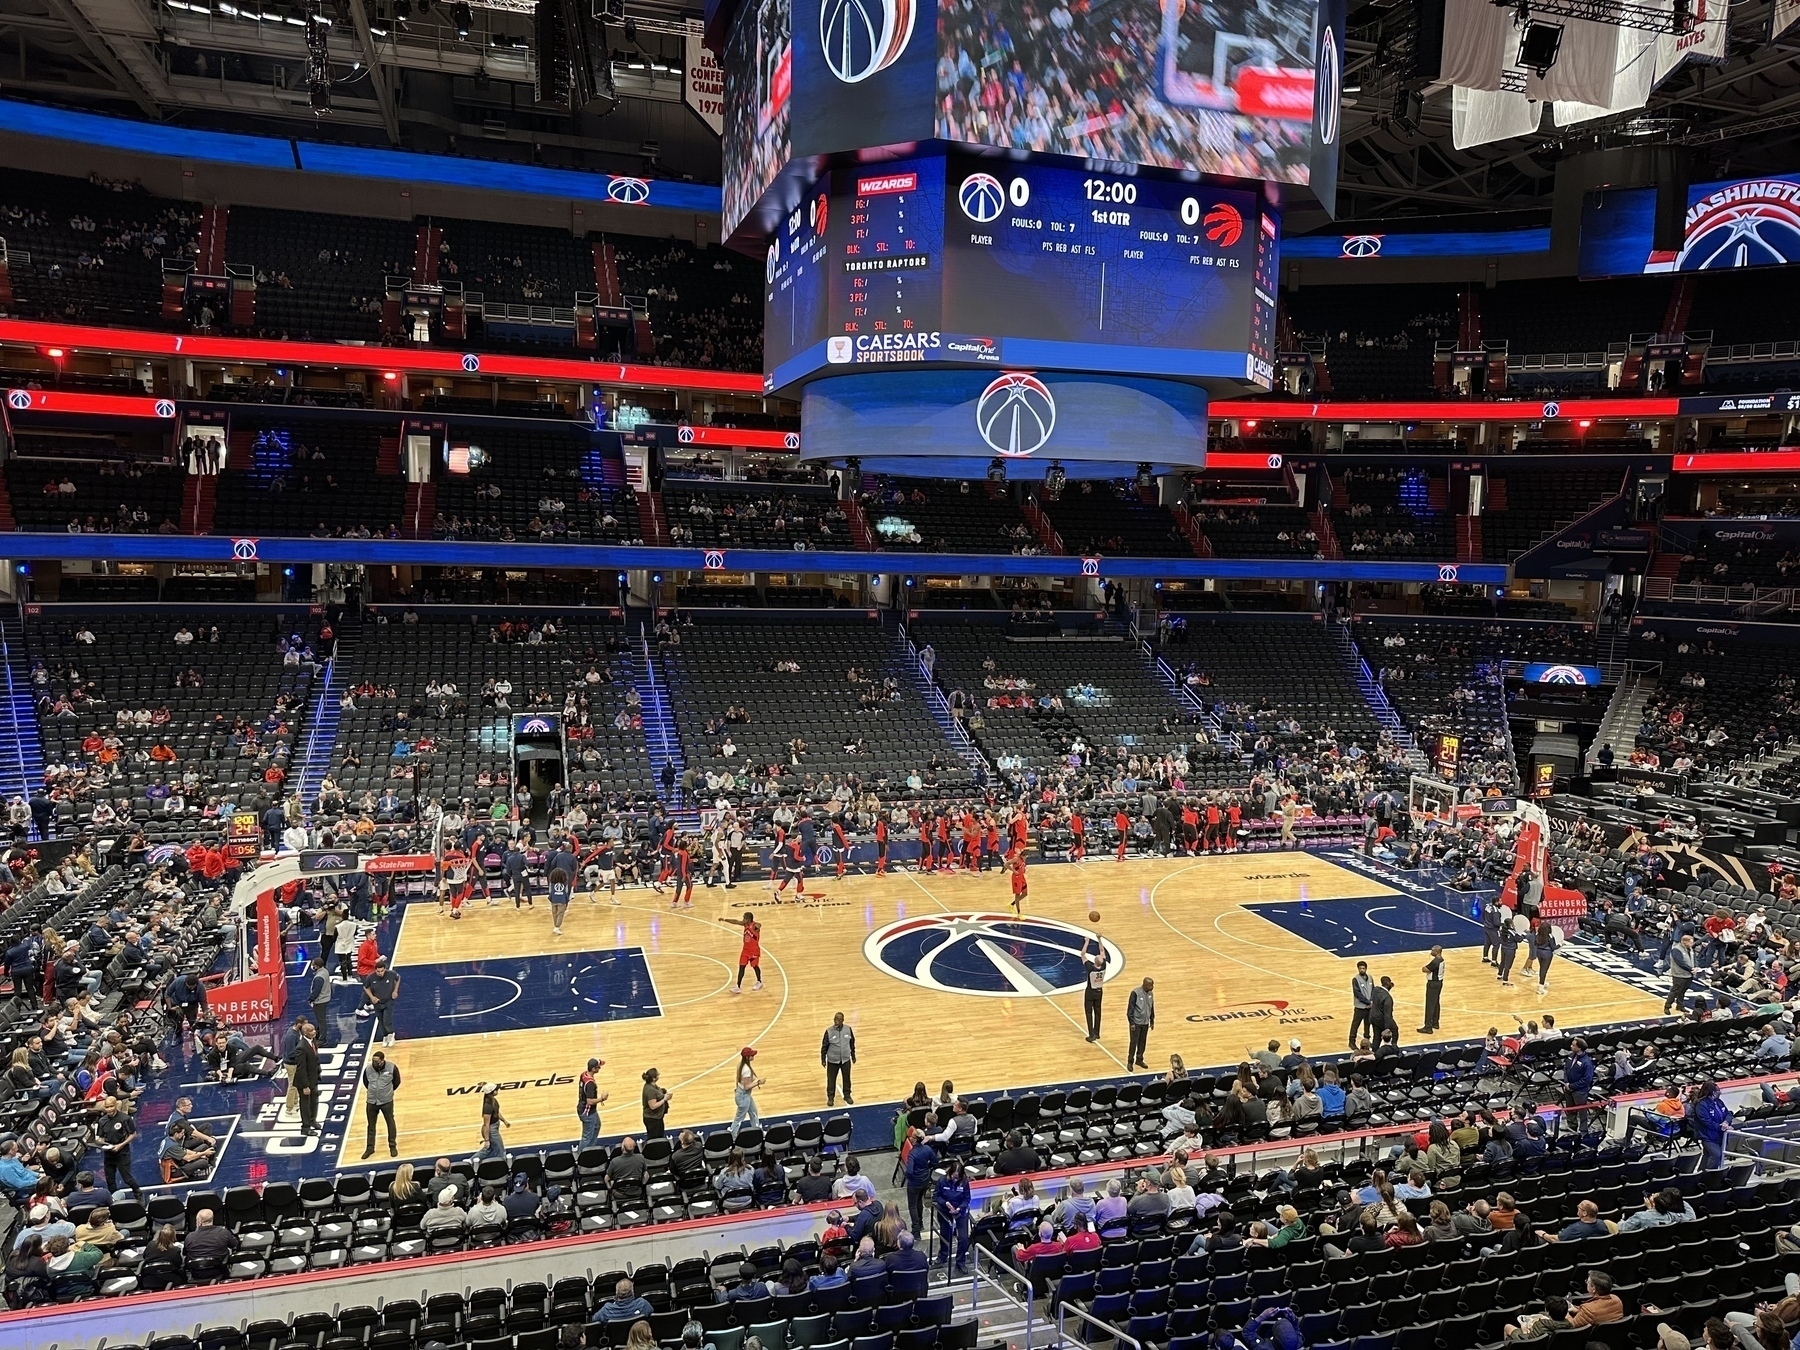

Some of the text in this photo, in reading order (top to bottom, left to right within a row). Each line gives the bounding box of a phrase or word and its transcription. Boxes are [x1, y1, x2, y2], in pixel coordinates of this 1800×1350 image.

[1676, 29, 1706, 52] HAYES
[699, 99, 724, 115] 1970
[860, 177, 914, 192] WIZARDS
[1083, 178, 1137, 204] 12:00
[1009, 177, 1030, 207] 0
[856, 200, 866, 210] FG:
[1181, 197, 1200, 226] 0
[810, 200, 816, 228] 0
[856, 214, 866, 224] PT:
[1091, 209, 1130, 226] 1st QTR
[1050, 222, 1066, 232] TOL:
[1070, 223, 1076, 232] 7
[856, 230, 865, 238] FT:
[970, 234, 992, 246] PLAYER
[1176, 234, 1190, 244] TOL:
[1194, 235, 1199, 244] 7
[774, 238, 780, 262] 0
[846, 240, 916, 254] BLK: STL: TO:
[1042, 242, 1096, 256] PTS REB AST FLS
[1124, 250, 1144, 260] PLAYER
[1190, 255, 1240, 268] PTS REB AST FLS
[846, 257, 926, 272] TORONTO RAPTORS
[854, 278, 864, 288] FG:
[854, 292, 864, 302] PT:
[854, 307, 864, 316] FT:
[845, 320, 914, 332] BLK: STL: TO:
[856, 332, 941, 350] CAESARS
[856, 350, 924, 363] SPORTSBOOK
[1254, 357, 1274, 380] CAESARS
[1442, 745, 1456, 762] 24
[234, 816, 254, 824] 12:00
[236, 824, 251, 835] 24
[1244, 872, 1310, 880] wizards
[1542, 908, 1587, 916] BEDERMAN
[1279, 1014, 1334, 1025] Arena
[446, 1072, 577, 1096] wiards
[321, 1043, 366, 1152] OF COLUMBIA
[255, 1102, 281, 1124] THE
